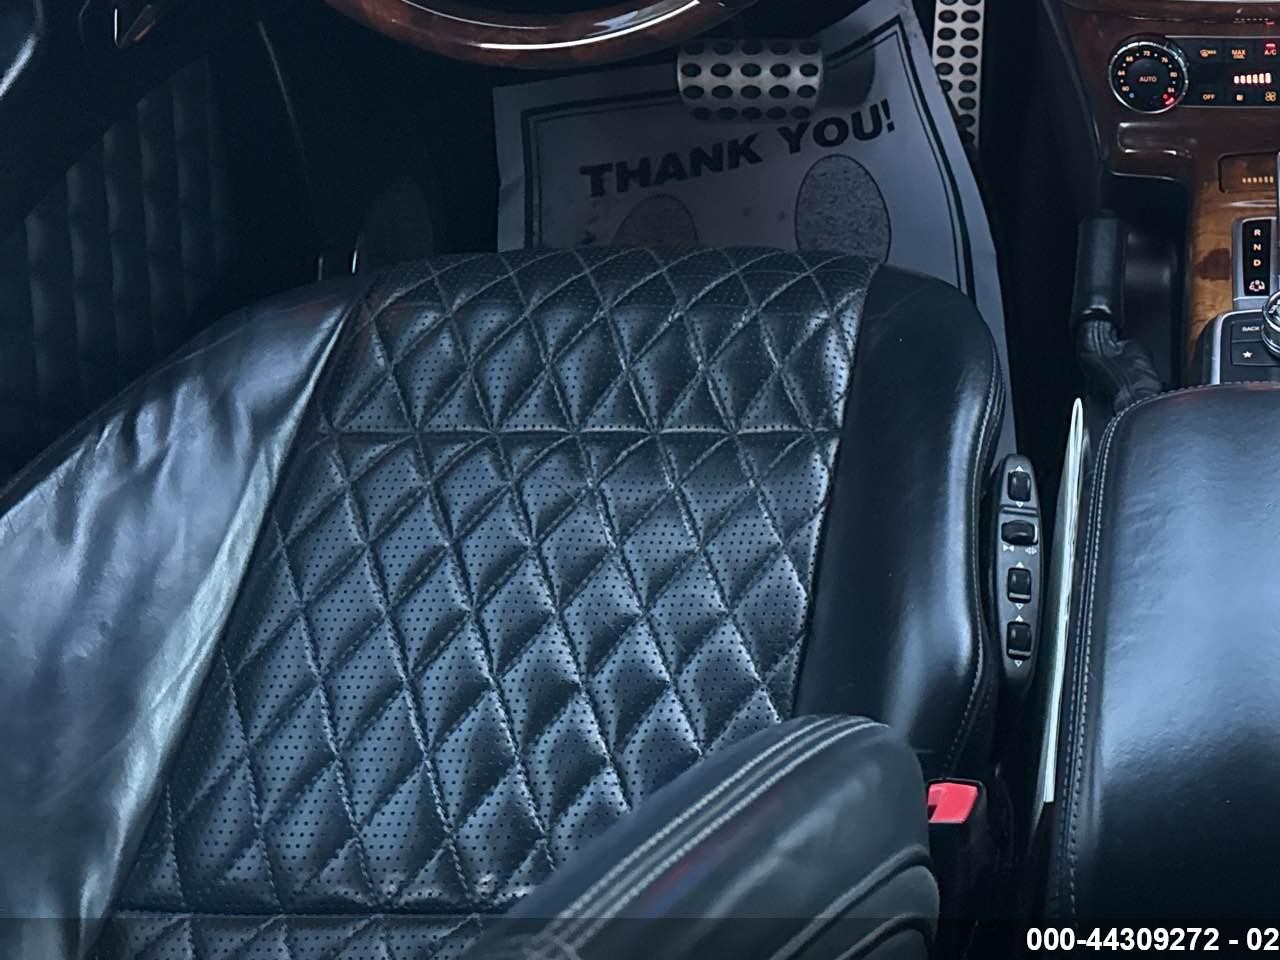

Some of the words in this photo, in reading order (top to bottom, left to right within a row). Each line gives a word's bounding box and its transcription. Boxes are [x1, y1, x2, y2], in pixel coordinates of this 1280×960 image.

[1264, 48, 1278, 56] A/C
[1202, 93, 1215, 101] OFF
[579, 132, 763, 198] THANK
[777, 98, 895, 155] YOU!
[1253, 228, 1261, 237] R
[1253, 243, 1262, 251] N
